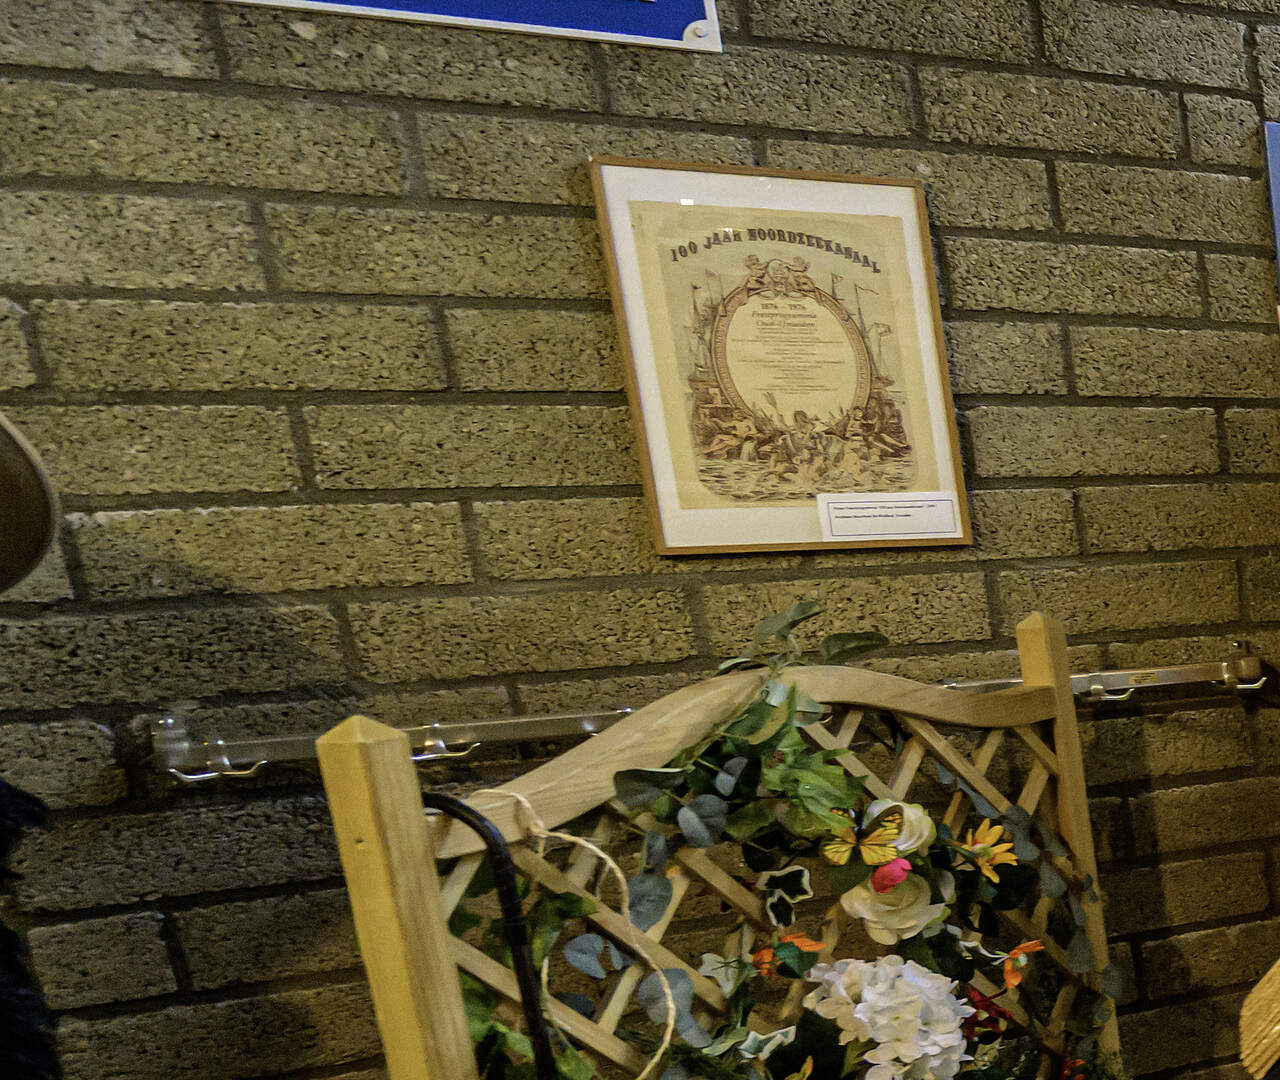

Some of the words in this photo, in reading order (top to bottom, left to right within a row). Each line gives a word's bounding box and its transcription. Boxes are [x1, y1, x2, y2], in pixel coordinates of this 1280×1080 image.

[670, 241, 698, 262] 100
[703, 230, 743, 250] JAAR
[747, 228, 881, 274] NOORDZEEKANAAL
